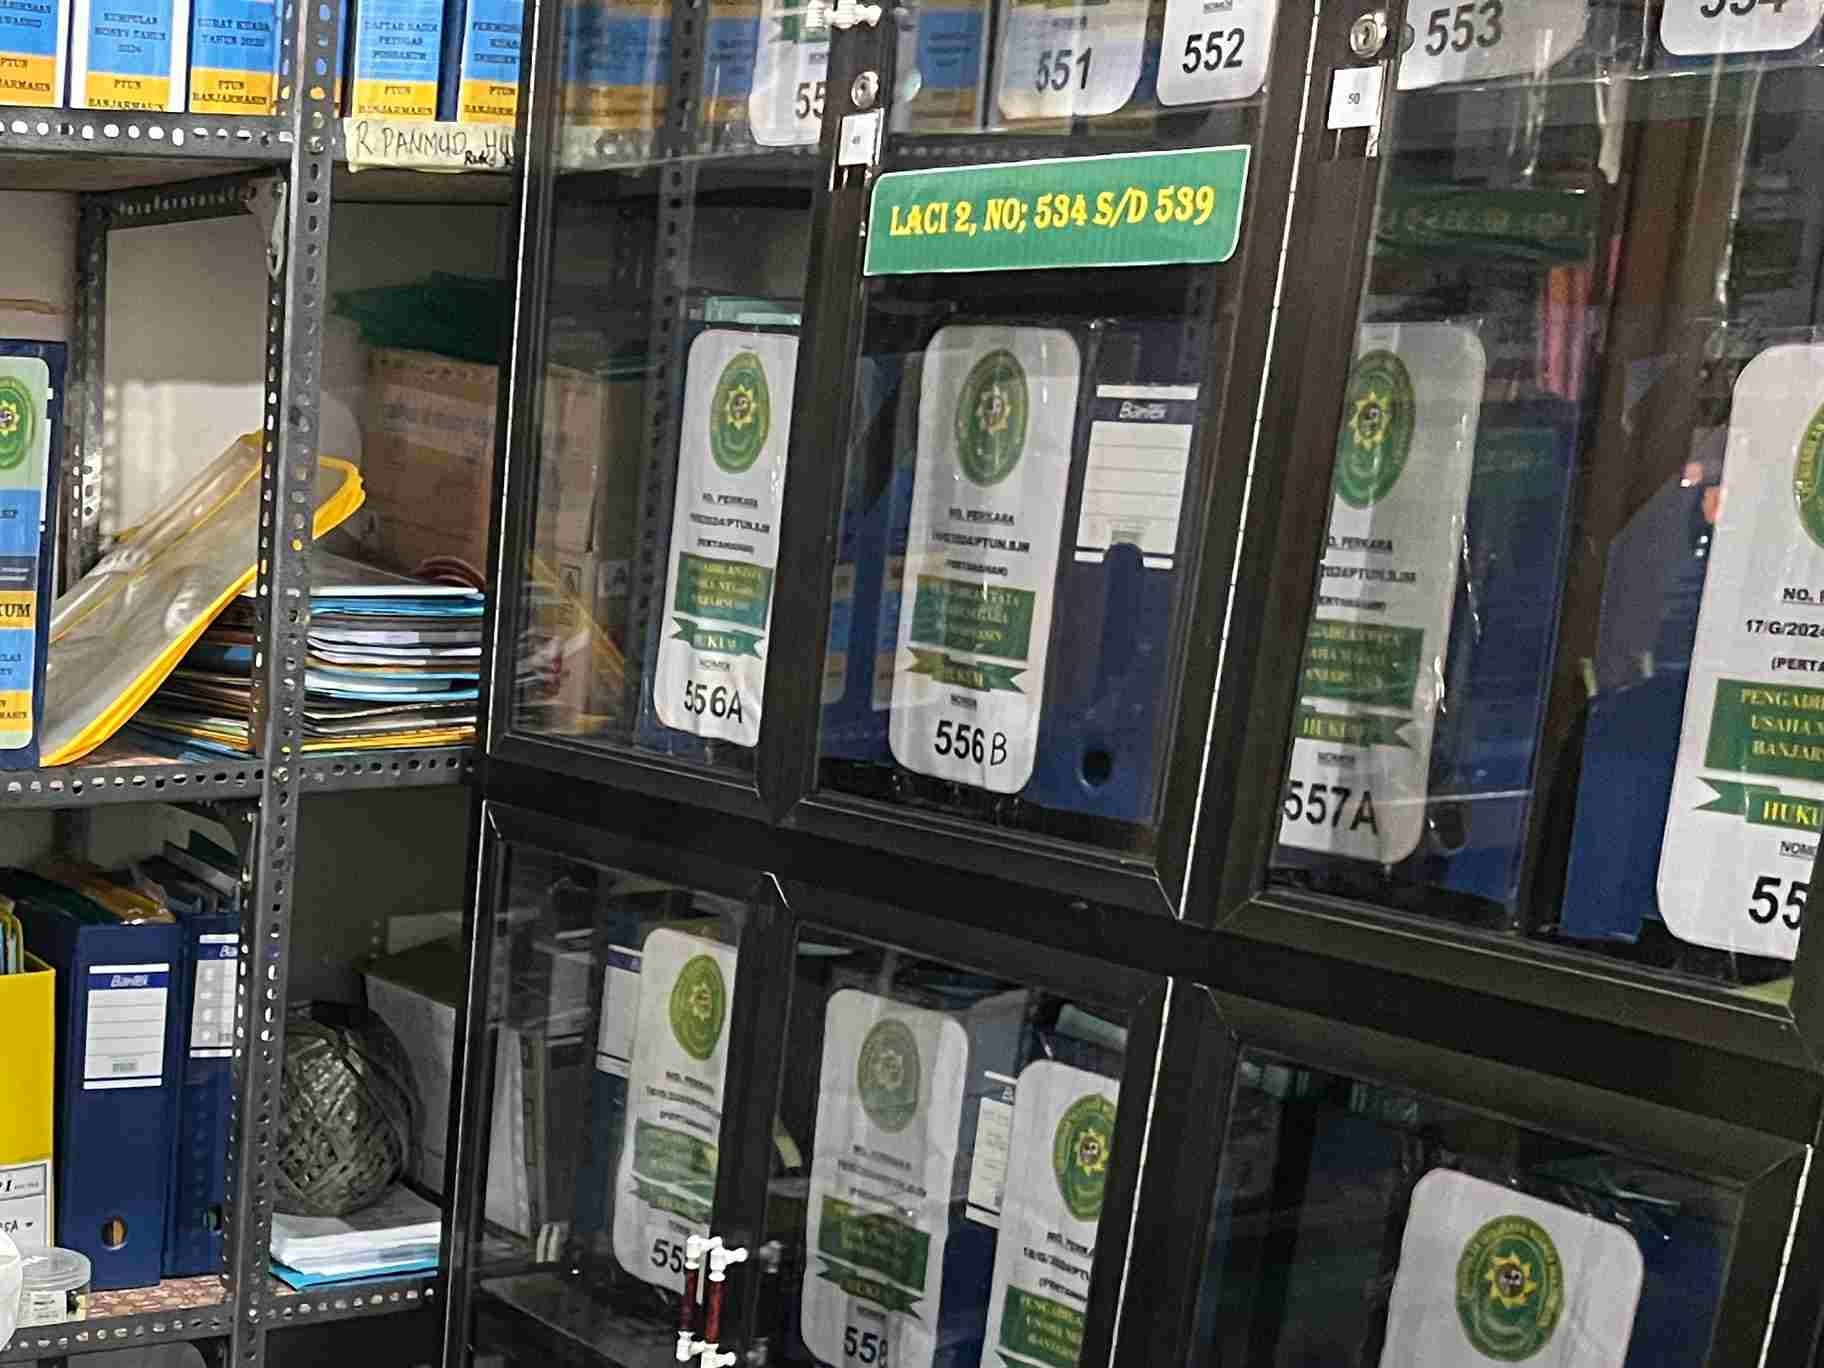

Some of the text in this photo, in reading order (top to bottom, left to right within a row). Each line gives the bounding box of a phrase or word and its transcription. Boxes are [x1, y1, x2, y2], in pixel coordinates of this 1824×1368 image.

[1424, 2, 1504, 57] 553
[1182, 27, 1246, 74] 552
[0, 57, 28, 69] PTUN
[1034, 46, 1093, 95] 551
[113, 79, 142, 90] PTUN
[218, 79, 245, 91] PTUN
[889, 204, 949, 237] LACI
[954, 201, 977, 237] 2,
[1033, 194, 1087, 226] 534
[1092, 189, 1149, 227] S/D
[1154, 185, 1216, 226] 539
[967, 509, 1016, 526] PERKARA
[1782, 587, 1815, 604] NO.
